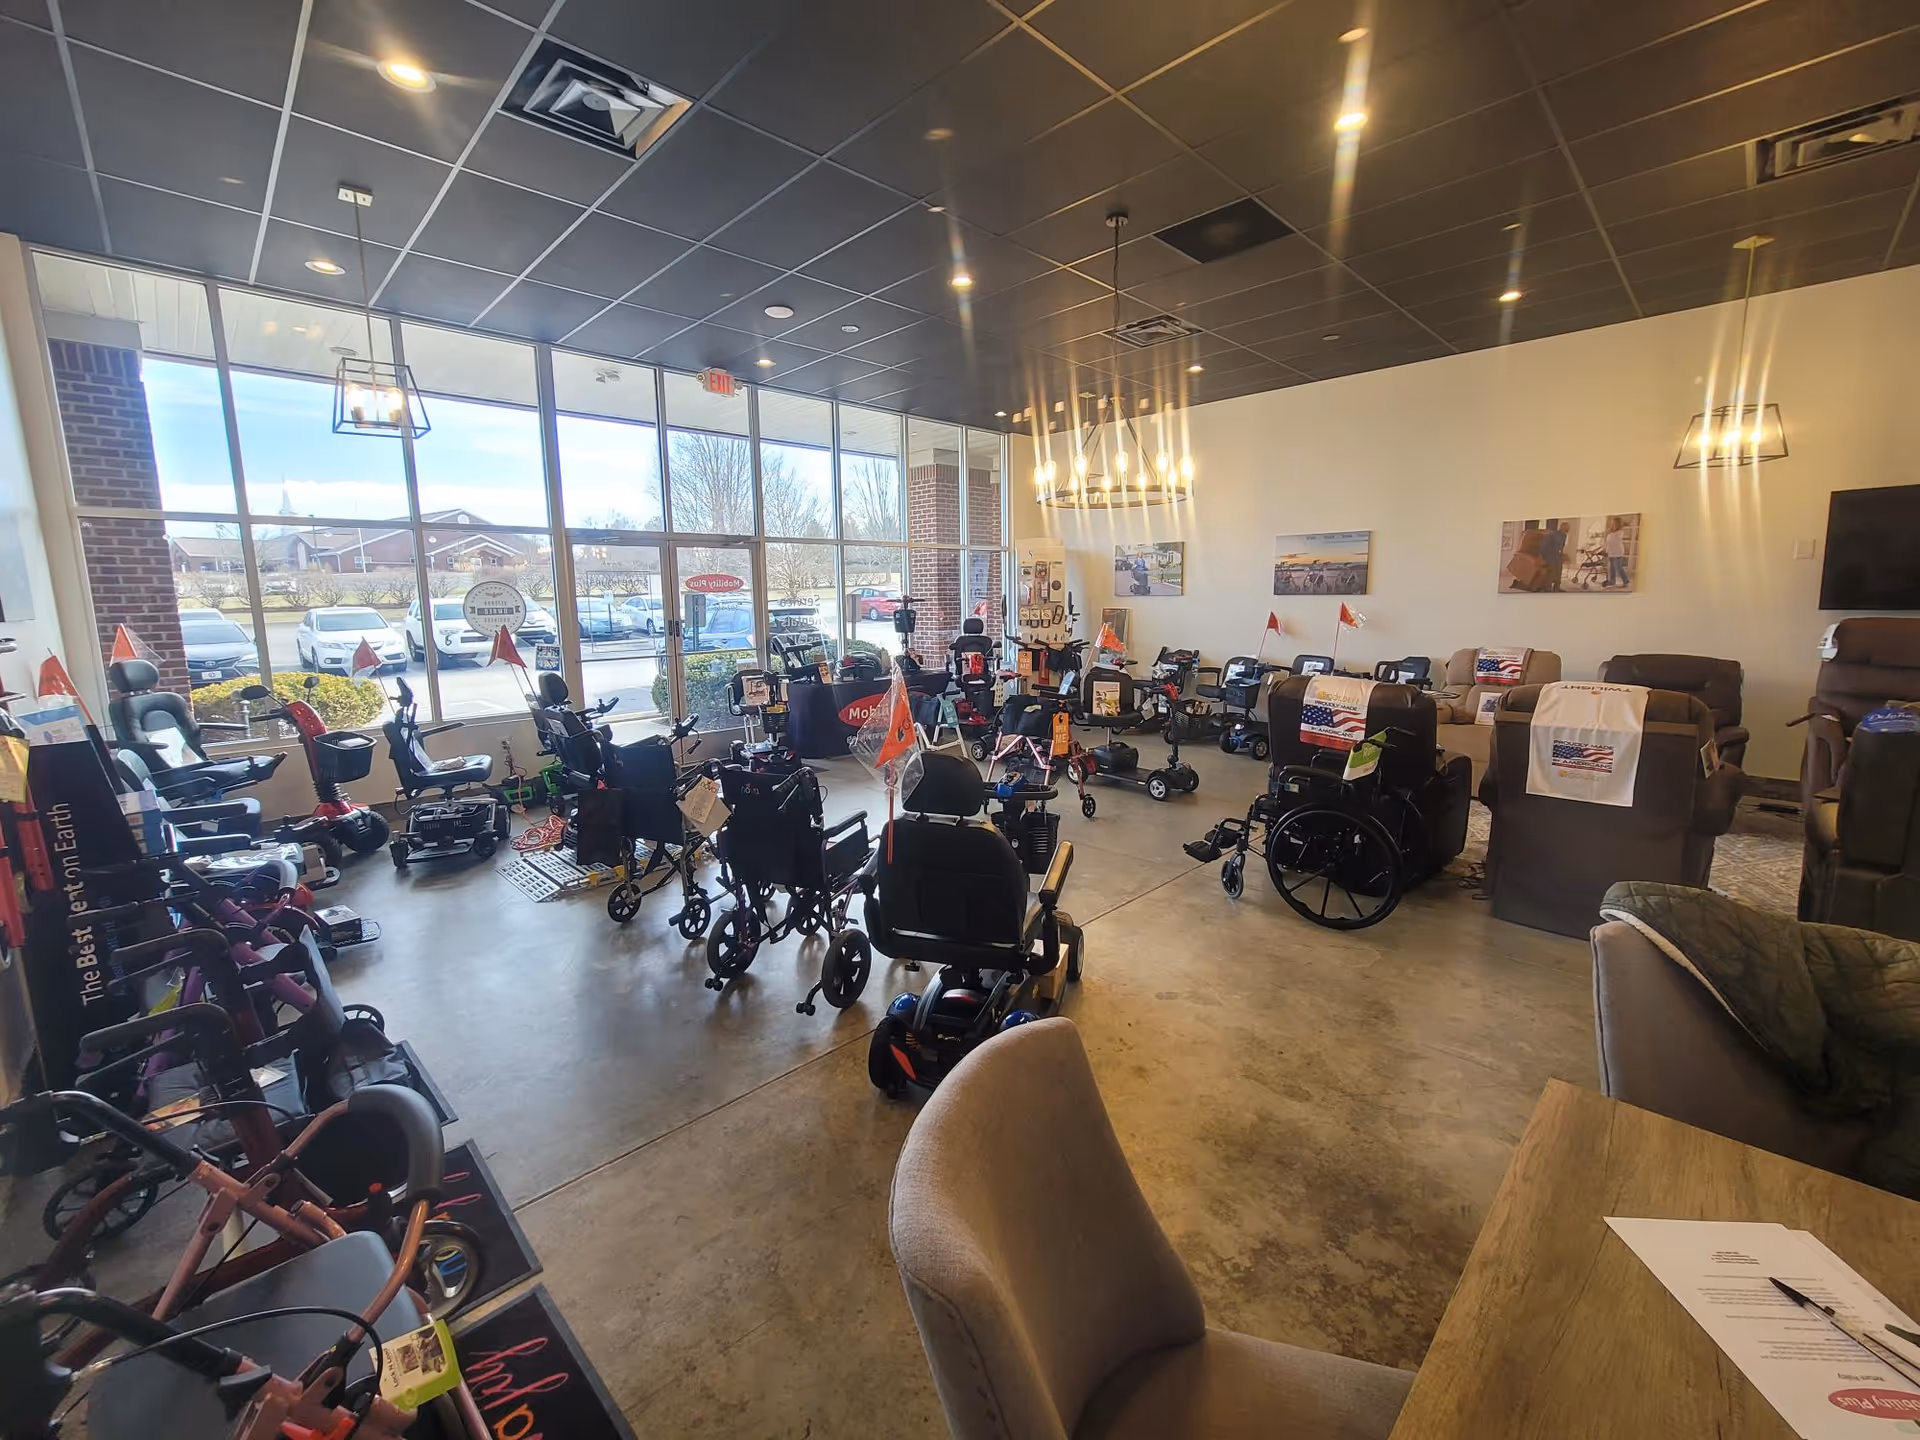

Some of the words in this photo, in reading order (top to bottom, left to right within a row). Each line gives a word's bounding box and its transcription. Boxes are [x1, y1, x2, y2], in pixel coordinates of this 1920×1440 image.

[710, 372, 733, 394] EXIT
[1314, 700, 1339, 708] PROUDLY
[1340, 703, 1358, 711] MADE
[1055, 733, 1067, 744] ME
[1317, 727, 1354, 738] AMERICANS
[1553, 740, 1588, 748] PROUDLY
[1562, 759, 1613, 769] AMERICANS
[47, 802, 77, 852] Earth
[61, 855, 81, 879] on
[71, 925, 98, 969] Best
[79, 970, 104, 1006] The
[1836, 1396, 1875, 1410] Plus
[1872, 1394, 1920, 1413] obility
